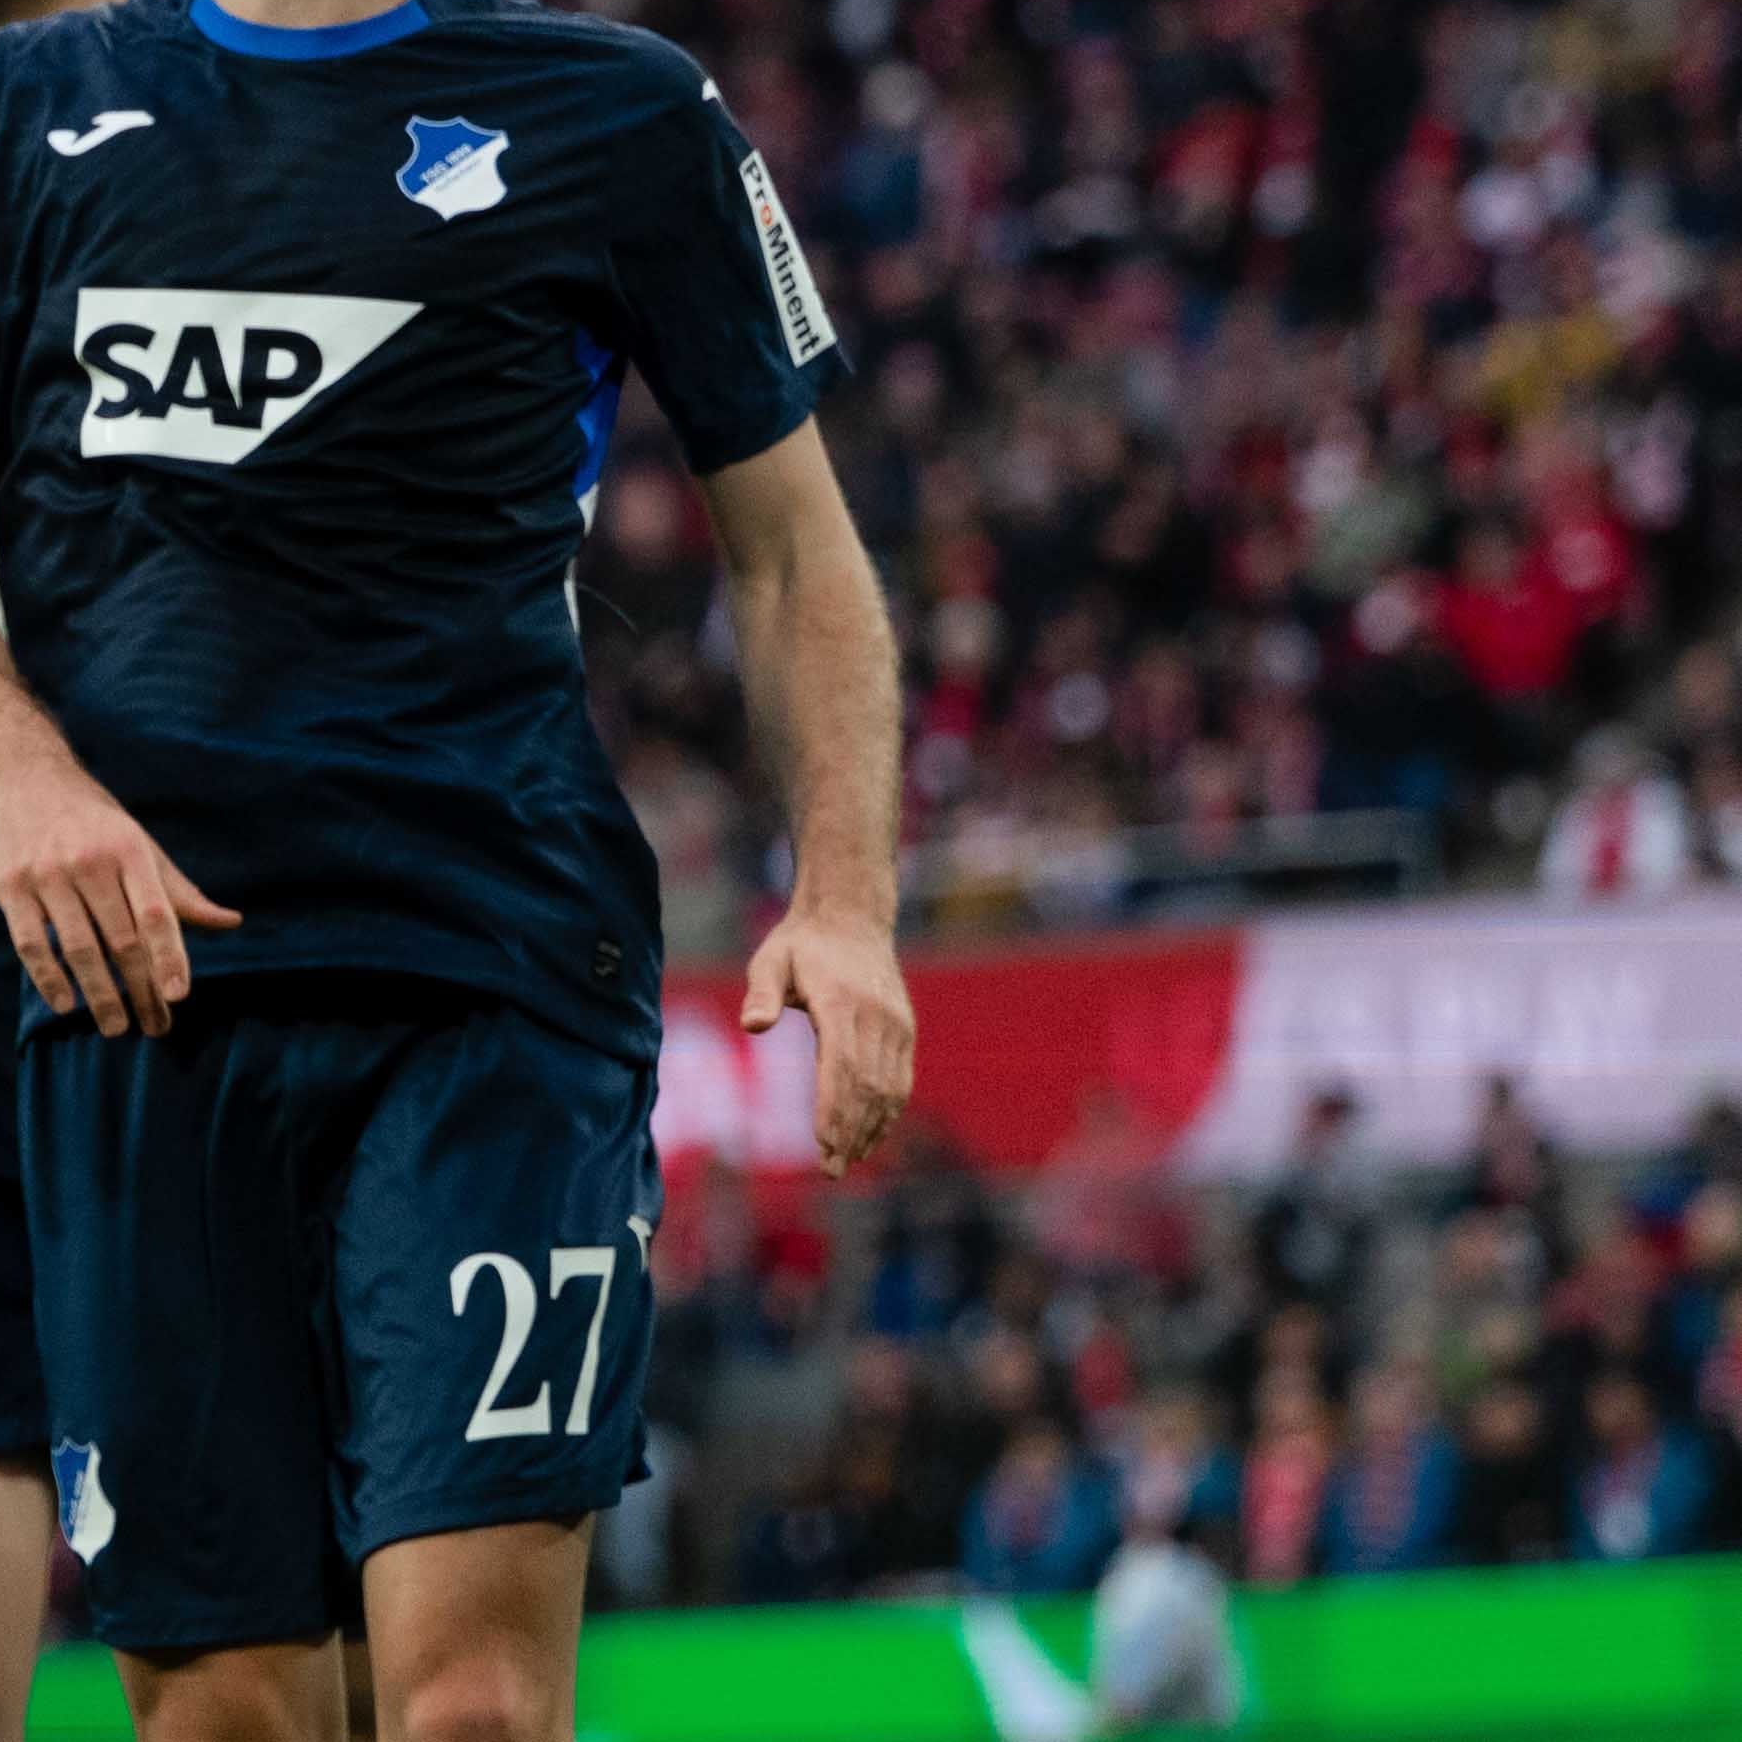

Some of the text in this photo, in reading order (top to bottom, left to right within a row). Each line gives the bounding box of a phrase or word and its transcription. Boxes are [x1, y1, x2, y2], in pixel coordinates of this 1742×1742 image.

[744, 160, 821, 357] ProMinent
[82, 322, 324, 431] SAP
[449, 1245, 616, 1443] 27
